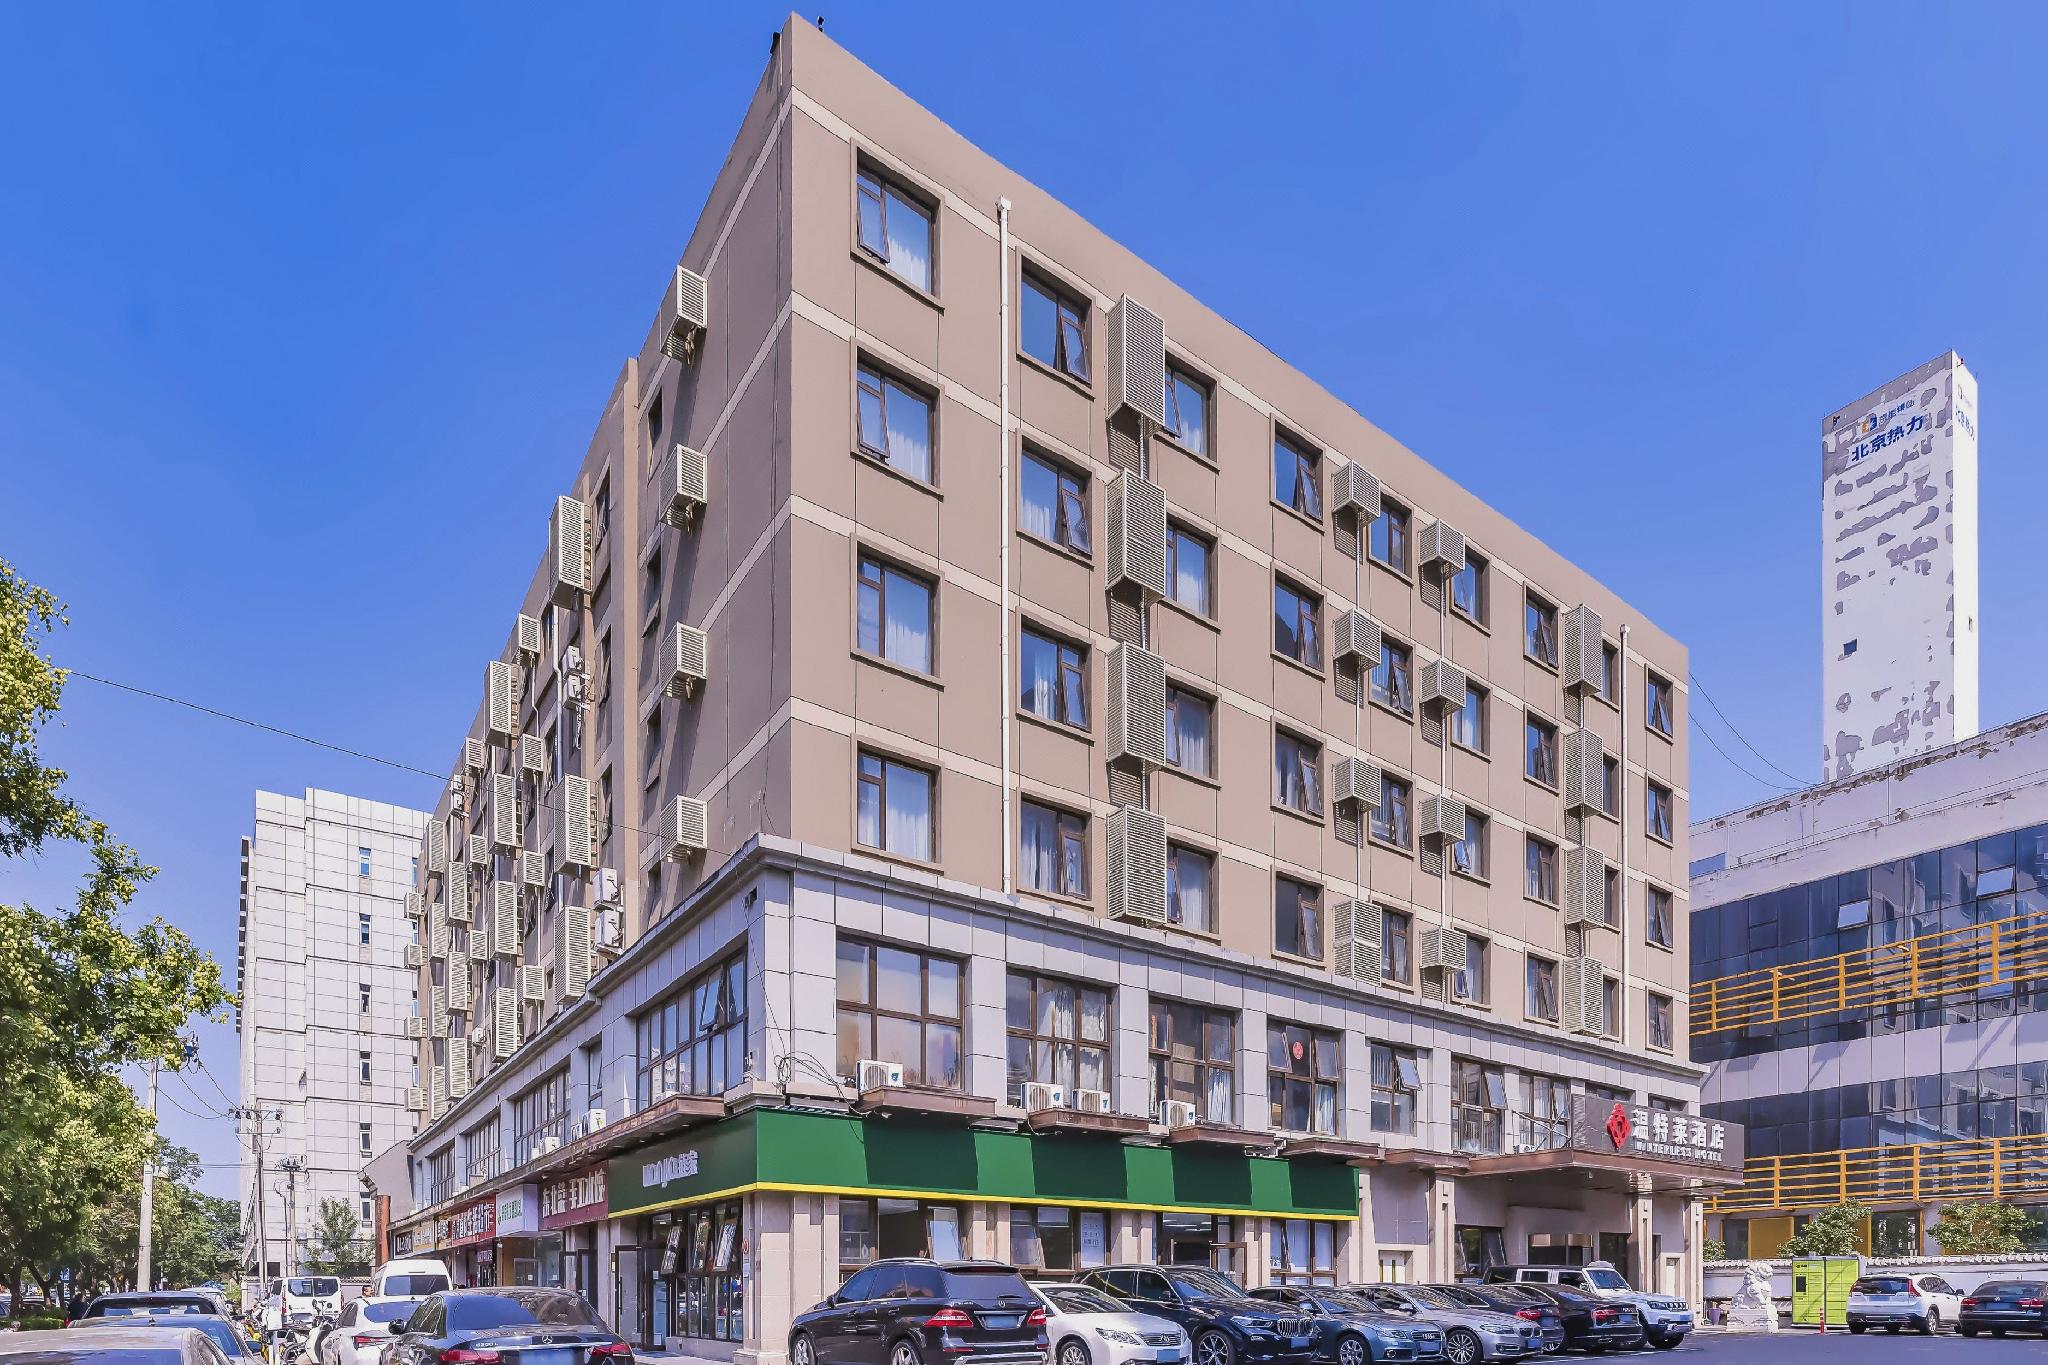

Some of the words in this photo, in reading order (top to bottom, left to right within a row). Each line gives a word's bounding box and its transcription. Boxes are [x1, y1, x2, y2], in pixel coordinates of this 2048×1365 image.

[1851, 415, 1925, 461] 北京热力
[1694, 1149, 1722, 1161] HOTEL
